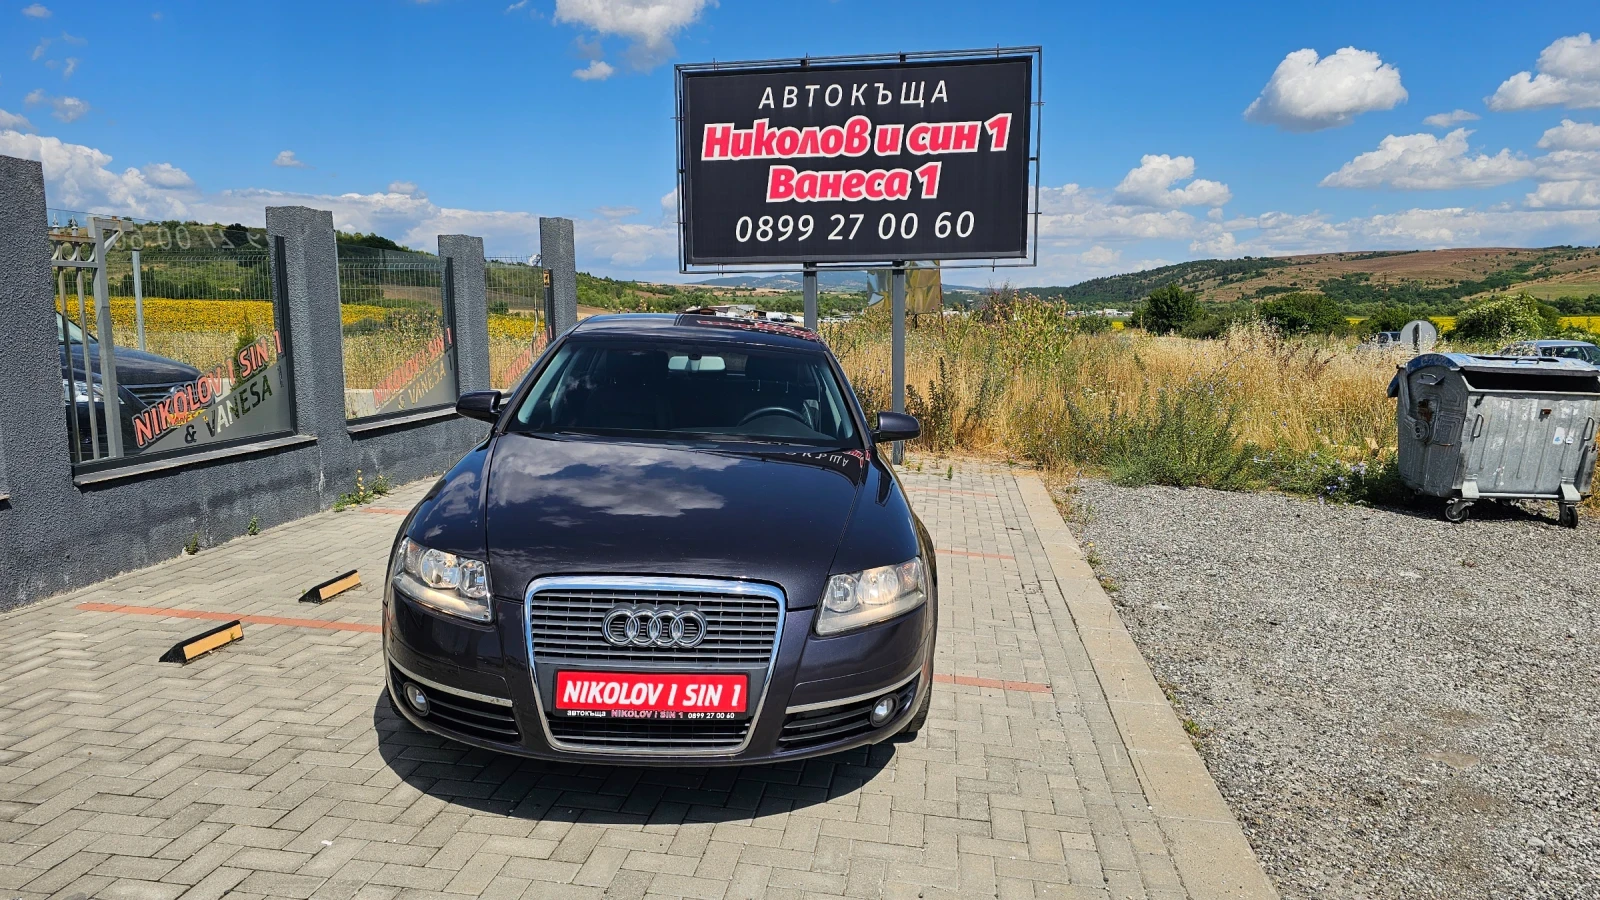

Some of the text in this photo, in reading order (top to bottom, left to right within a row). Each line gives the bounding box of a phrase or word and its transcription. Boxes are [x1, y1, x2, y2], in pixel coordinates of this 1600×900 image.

[758, 80, 948, 109] АВТОКЪЩА
[701, 113, 1012, 161] Николов и син 1
[766, 161, 942, 202] Ванеса 1
[735, 210, 975, 243] 0899 27 00 60
[446, 327, 453, 345] 1
[133, 330, 283, 447] NIKOLOV I SIN 1
[408, 361, 446, 405] VANESA
[184, 424, 198, 444] &
[202, 374, 273, 438] VANESA
[563, 680, 742, 707] NIKOLOV I SIN 1
[567, 710, 606, 718] автокъща
[611, 709, 652, 718] NIKOLOV
